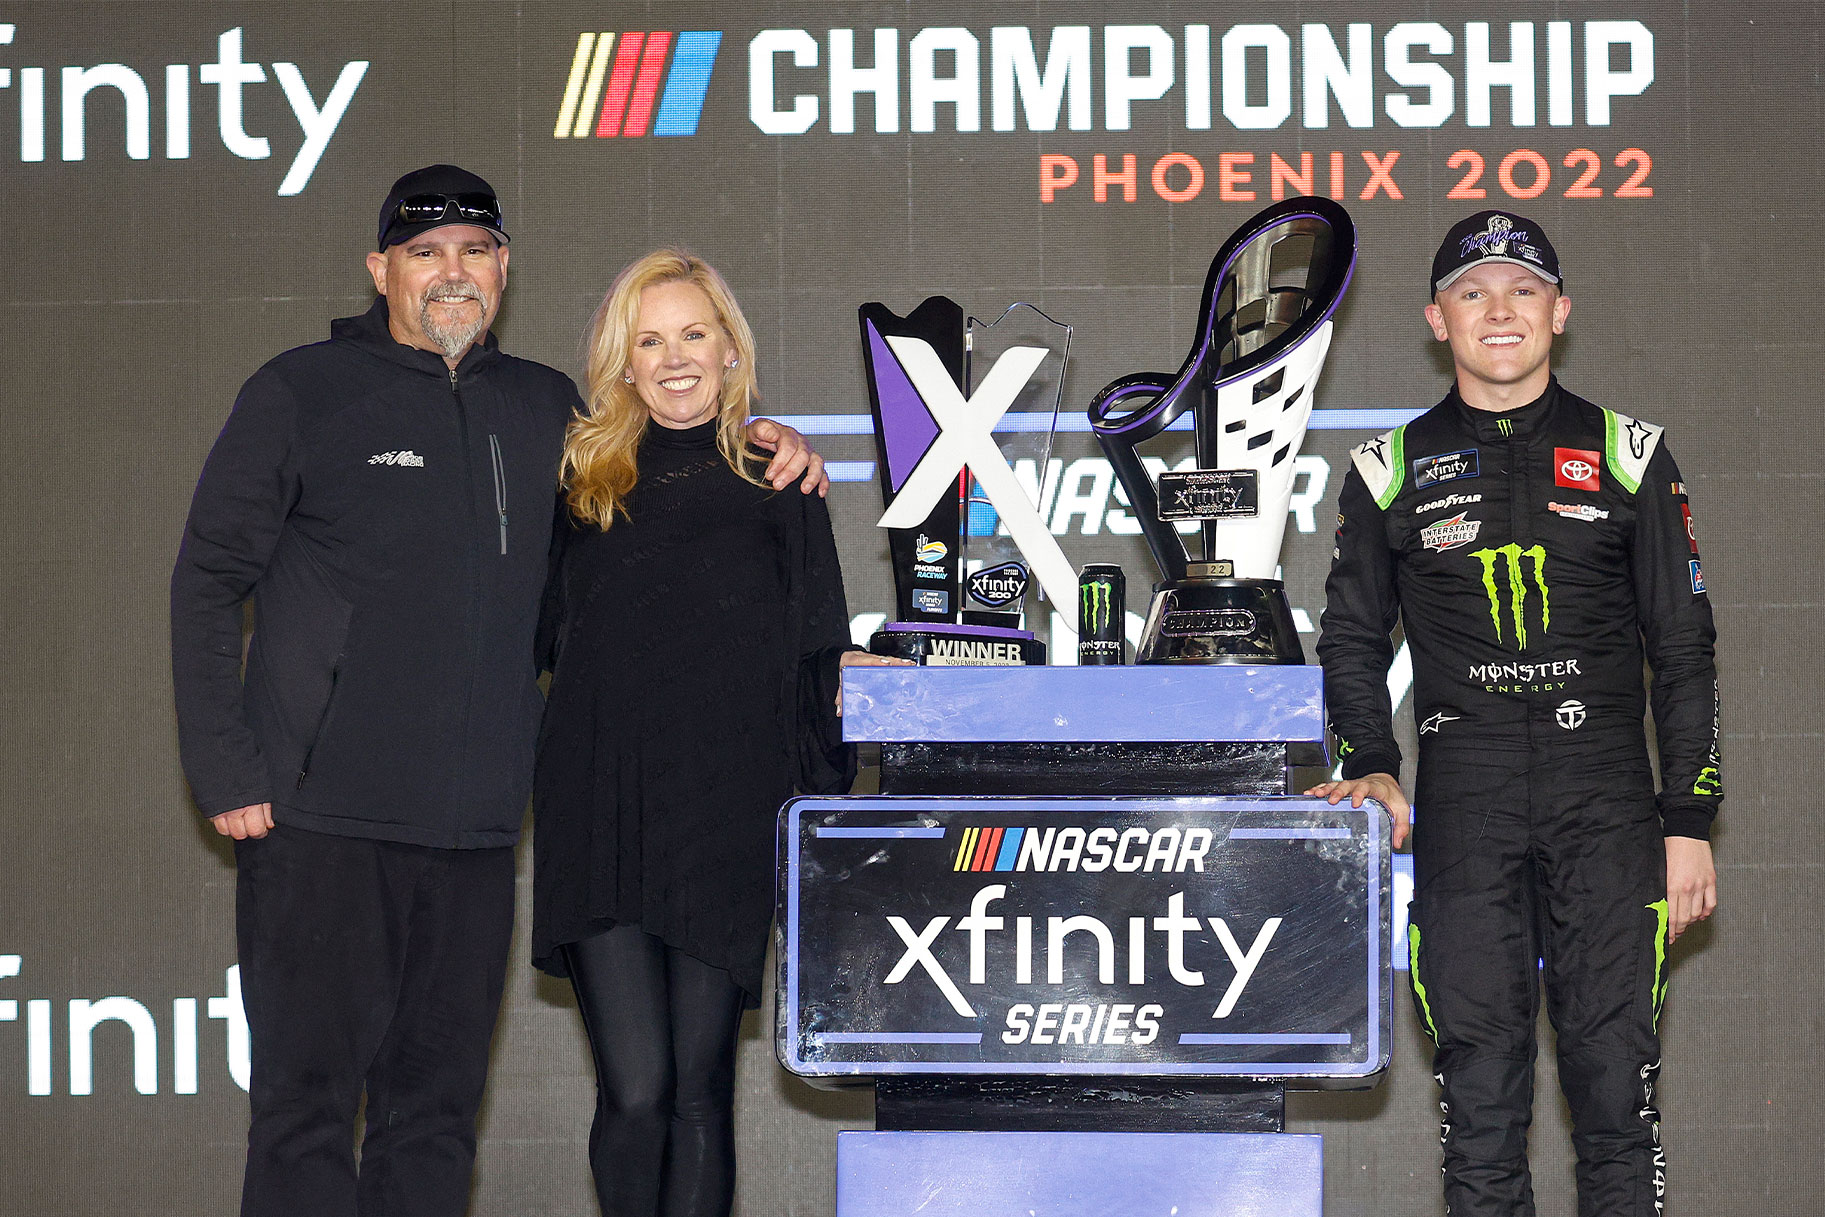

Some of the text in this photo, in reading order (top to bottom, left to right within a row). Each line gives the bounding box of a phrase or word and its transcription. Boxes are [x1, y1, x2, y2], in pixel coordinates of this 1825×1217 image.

[748, 20, 1655, 135] CHAMPIONSHIP
[1039, 147, 1654, 204] PHOENIX 2022
[1460, 229, 1528, 258] Champion
[1425, 461, 1469, 480] xfinity
[1415, 493, 1483, 515] GOODYEAR
[1423, 523, 1477, 537] INTERSTATE
[1426, 532, 1474, 546] BATTERIES
[914, 564, 946, 573] PHOENIX
[916, 571, 948, 580] RACEWAY
[971, 574, 1026, 597] xfinity
[988, 591, 1012, 599] 200
[918, 595, 943, 606] xfinity
[930, 639, 1021, 661] WINNER
[1468, 659, 1582, 683] MONSTER
[1485, 682, 1566, 693] ENERGY
[1016, 827, 1212, 873] NASCAR
[884, 884, 1283, 1019] xfinity
[1001, 1003, 1164, 1046] SERIES
